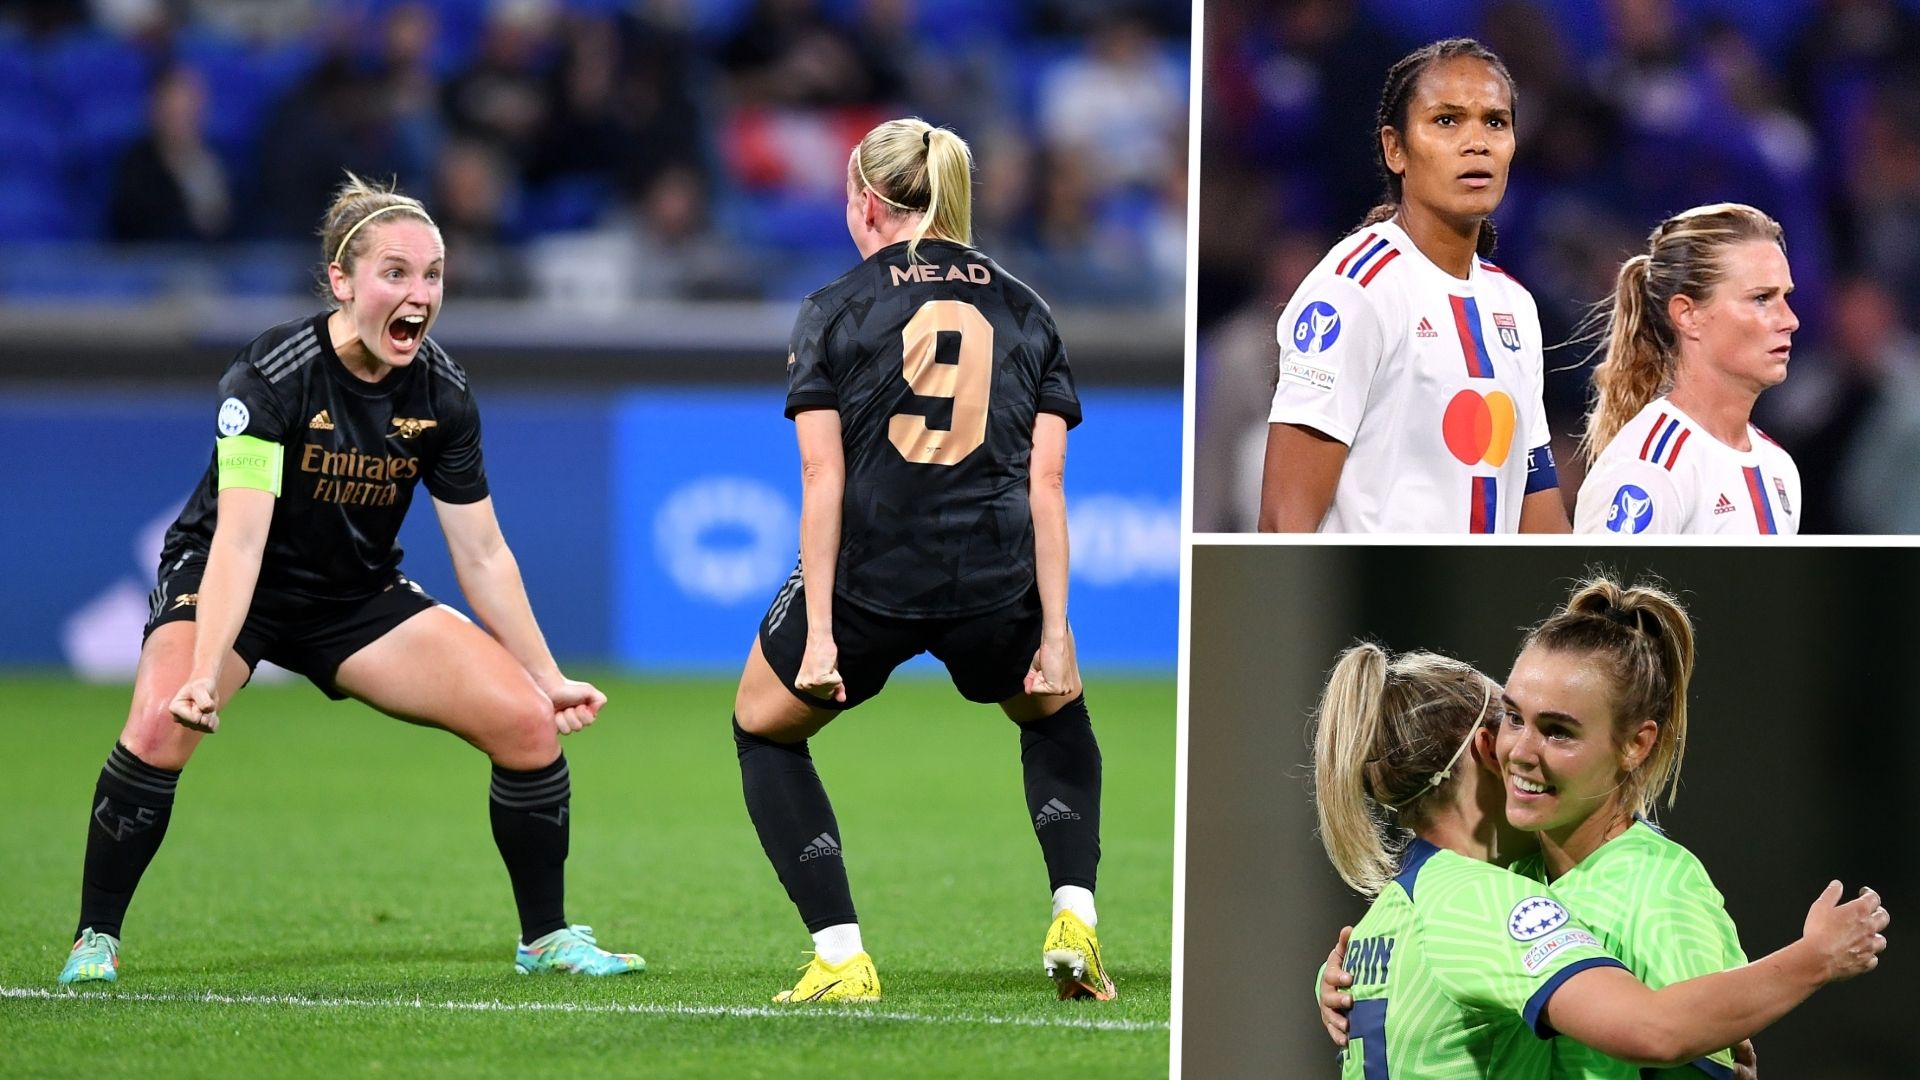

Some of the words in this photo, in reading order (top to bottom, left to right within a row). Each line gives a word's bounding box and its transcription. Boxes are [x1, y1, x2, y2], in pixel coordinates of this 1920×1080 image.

[890, 263, 991, 286] MEAD
[1295, 321, 1309, 341] 8
[888, 300, 994, 466] 9
[301, 443, 419, 481] Emirates
[1608, 503, 1620, 522] 8
[1035, 811, 1081, 831] adidas
[1343, 936, 1395, 986] ANN
